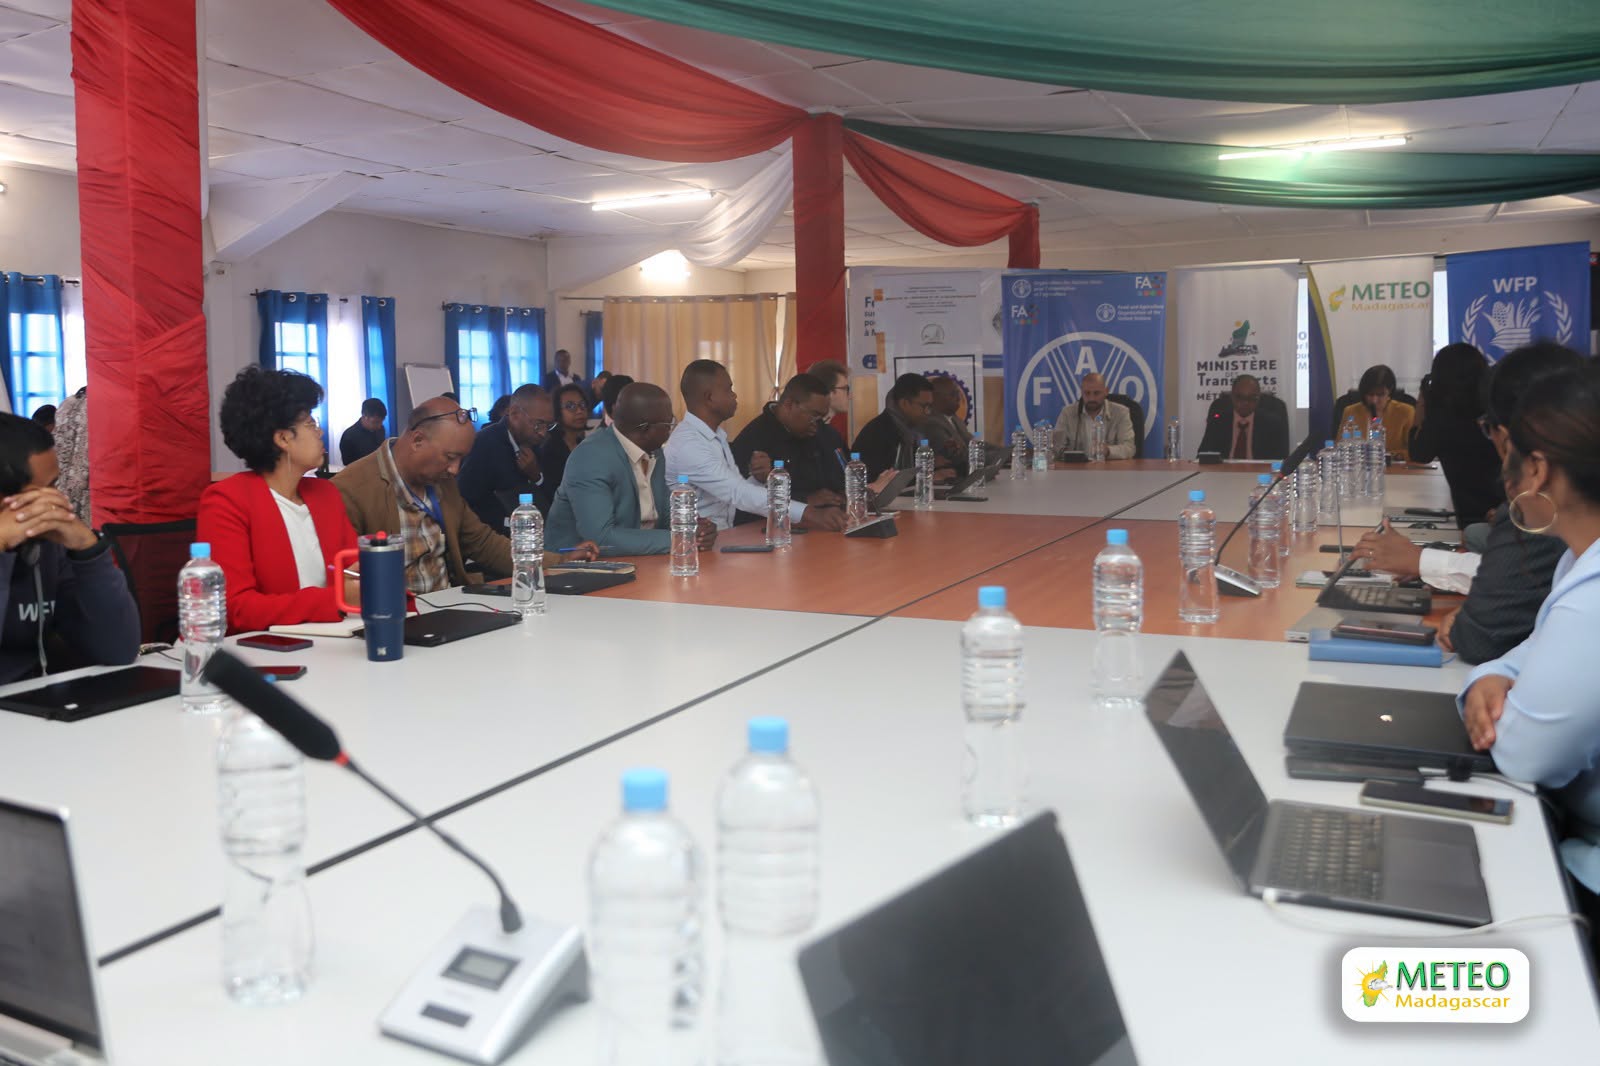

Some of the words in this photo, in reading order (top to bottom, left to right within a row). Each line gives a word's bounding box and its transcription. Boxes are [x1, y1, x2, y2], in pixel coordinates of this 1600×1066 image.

[1351, 281, 1431, 301] METEO
[1492, 276, 1538, 294] WFP
[1351, 302, 1430, 313] Madagascar
[1197, 357, 1277, 371] MINISTÈRE
